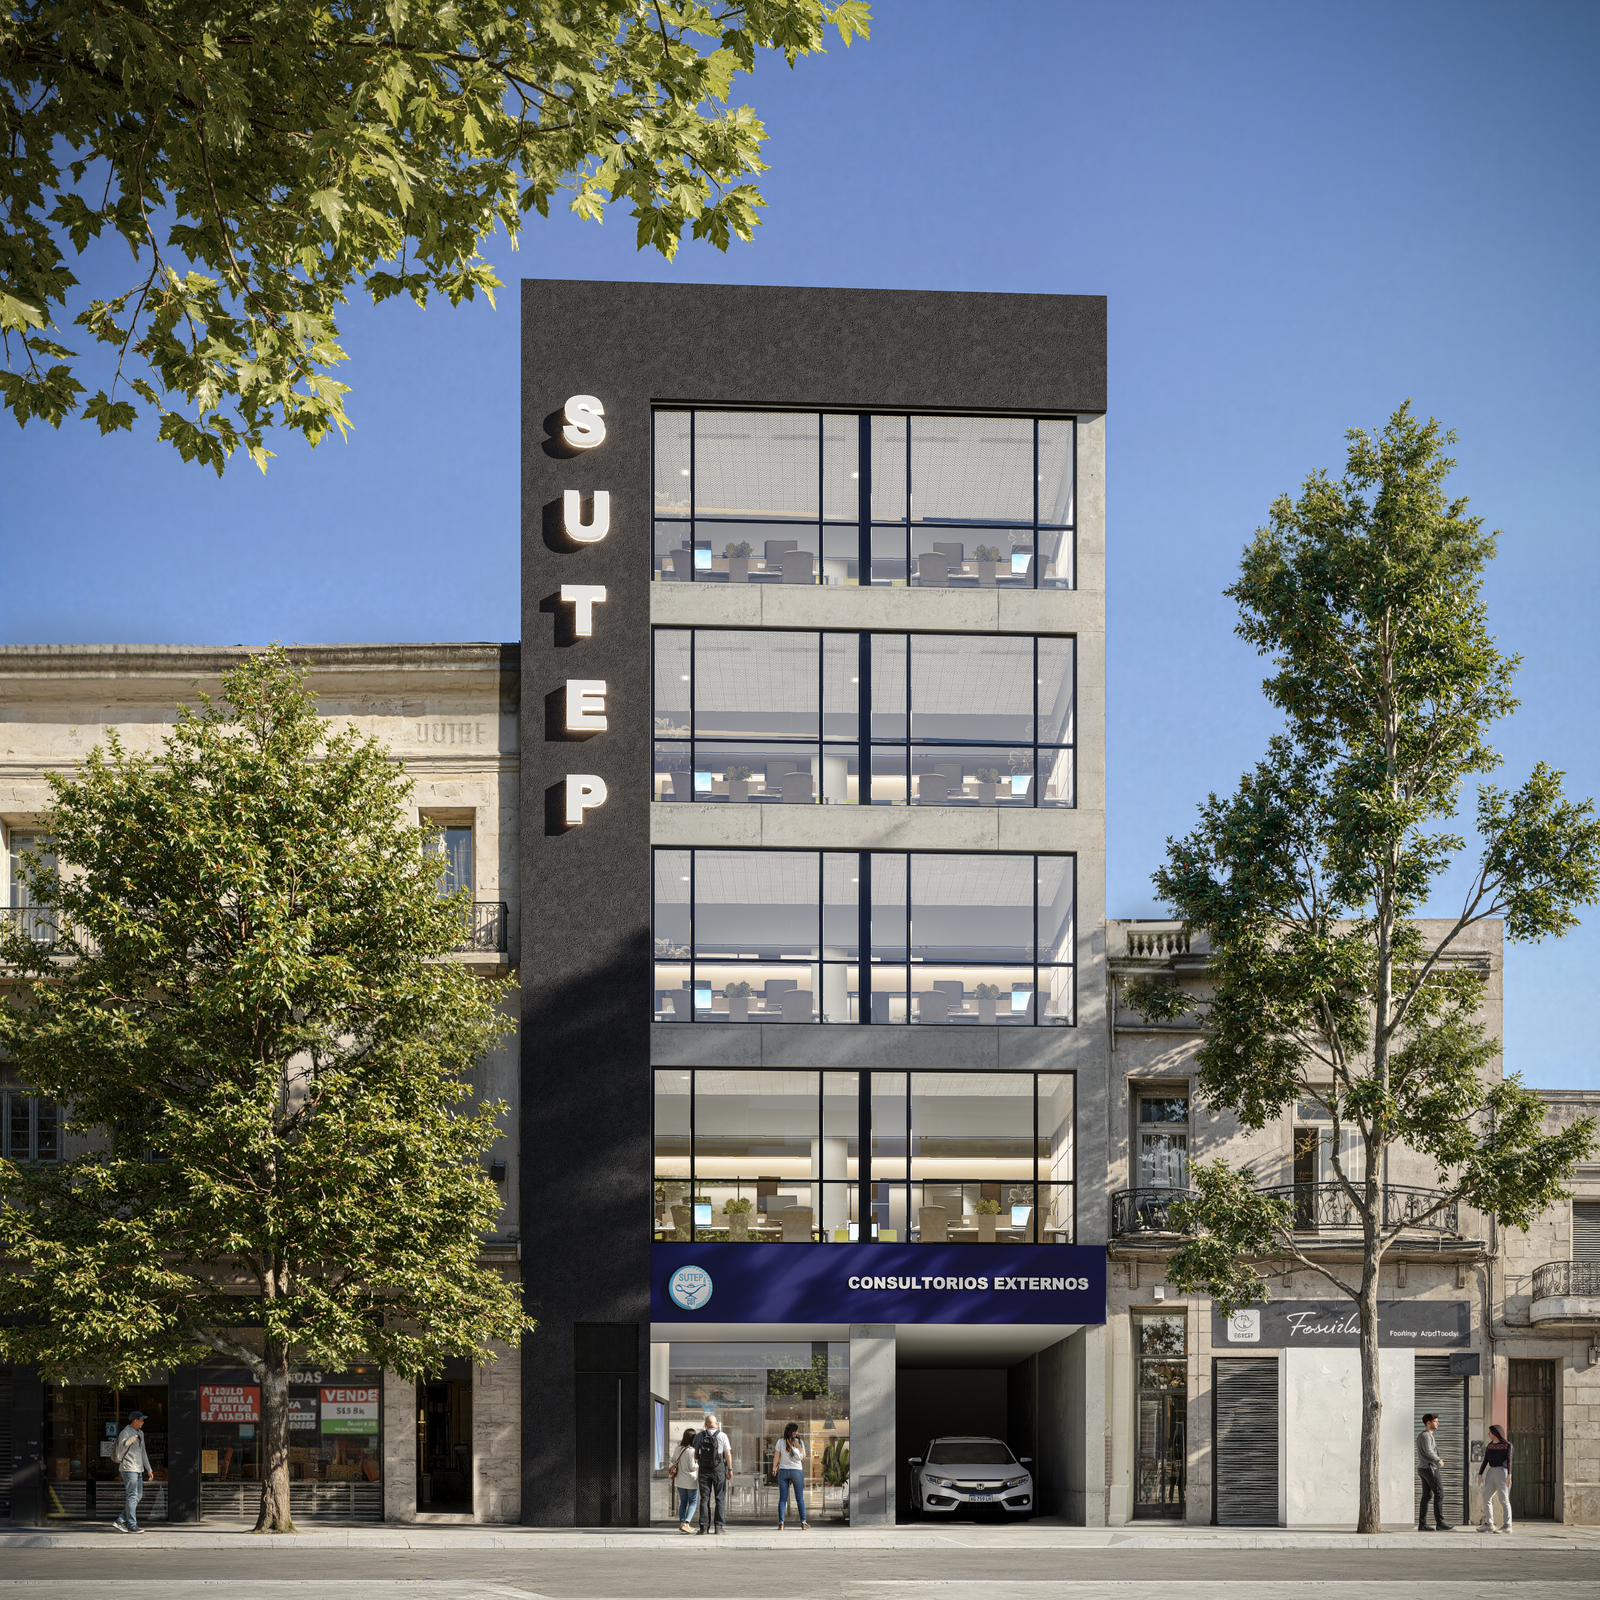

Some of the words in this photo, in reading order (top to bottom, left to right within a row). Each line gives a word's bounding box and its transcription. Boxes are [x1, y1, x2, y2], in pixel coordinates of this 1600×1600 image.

[560, 394, 611, 826] SUTEP
[678, 1273, 704, 1282] SUTEP
[848, 1276, 989, 1290] CONSULTORIOS
[994, 1277, 1090, 1291] EXTERNOS
[324, 1389, 377, 1402] VENDE
